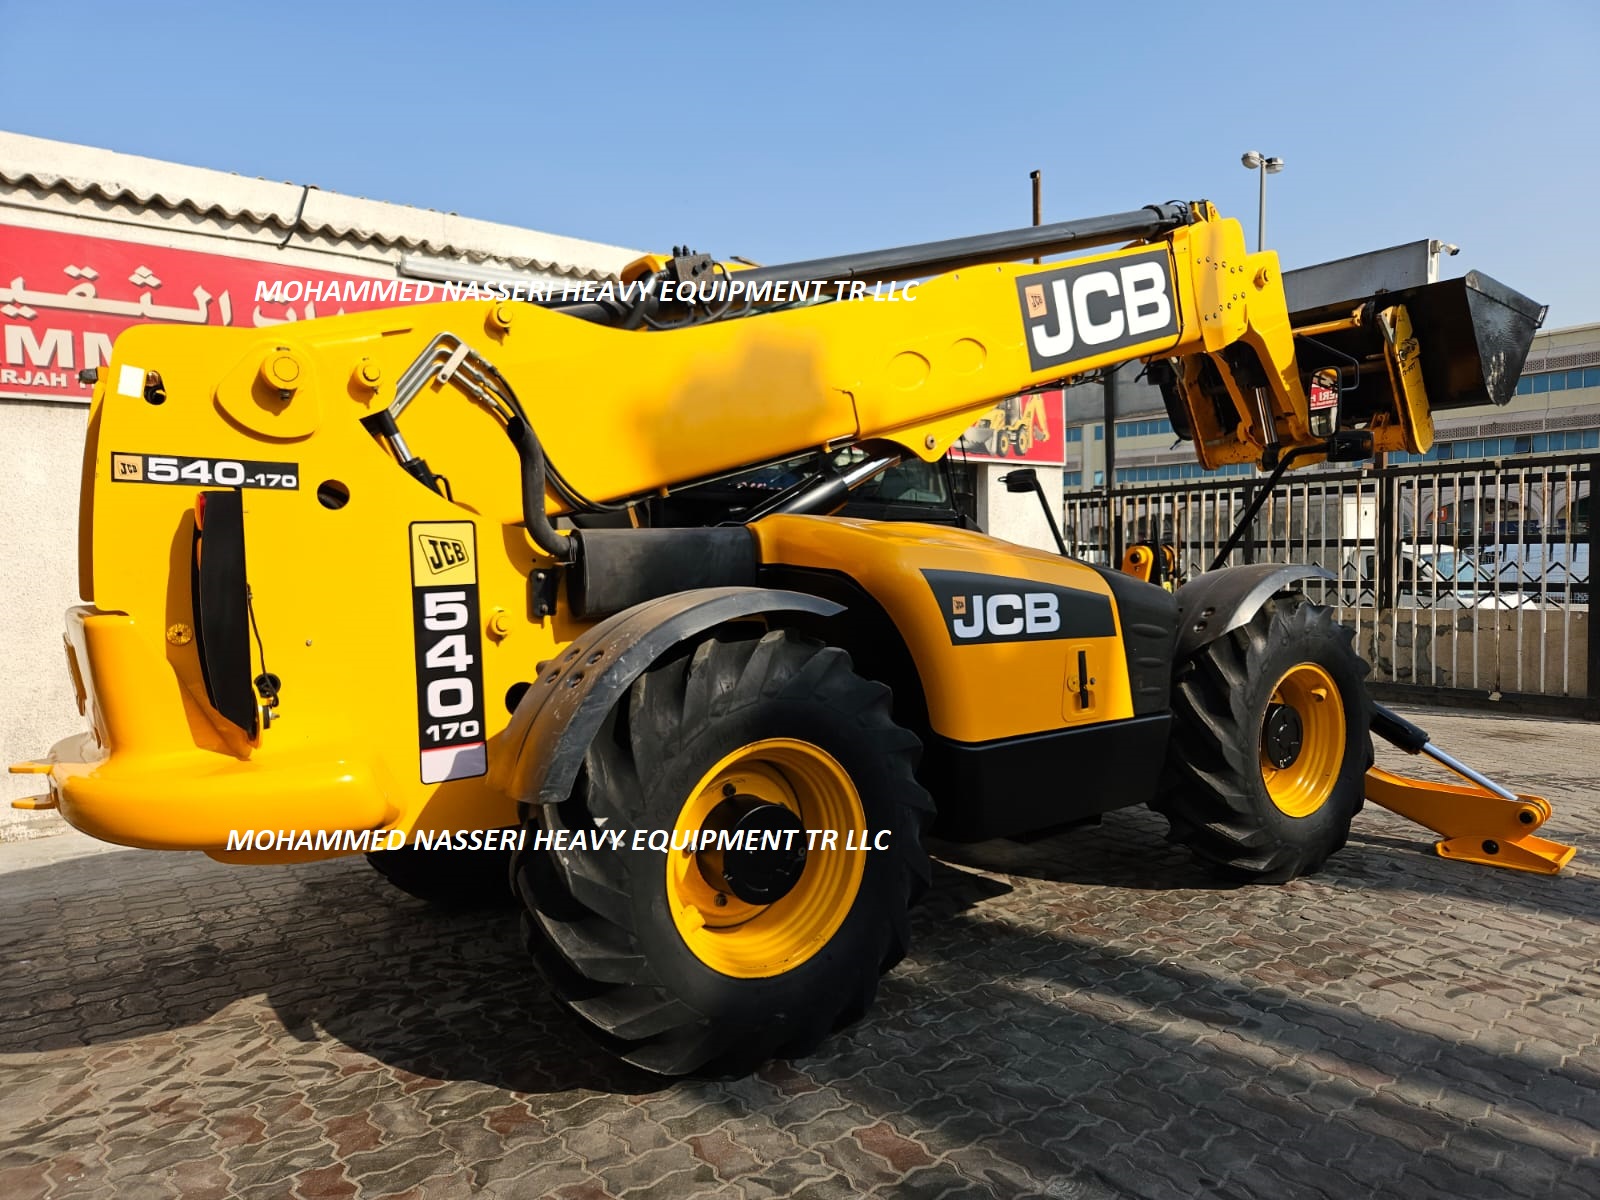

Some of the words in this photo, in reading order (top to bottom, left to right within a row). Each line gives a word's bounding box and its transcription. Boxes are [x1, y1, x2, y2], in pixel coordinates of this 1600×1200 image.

[1032, 261, 1171, 357] JCB
[119, 462, 138, 475] JCB
[147, 457, 297, 488] 540-170
[429, 539, 466, 569] JCB
[953, 592, 1061, 638] JCB
[426, 720, 480, 742] 170
